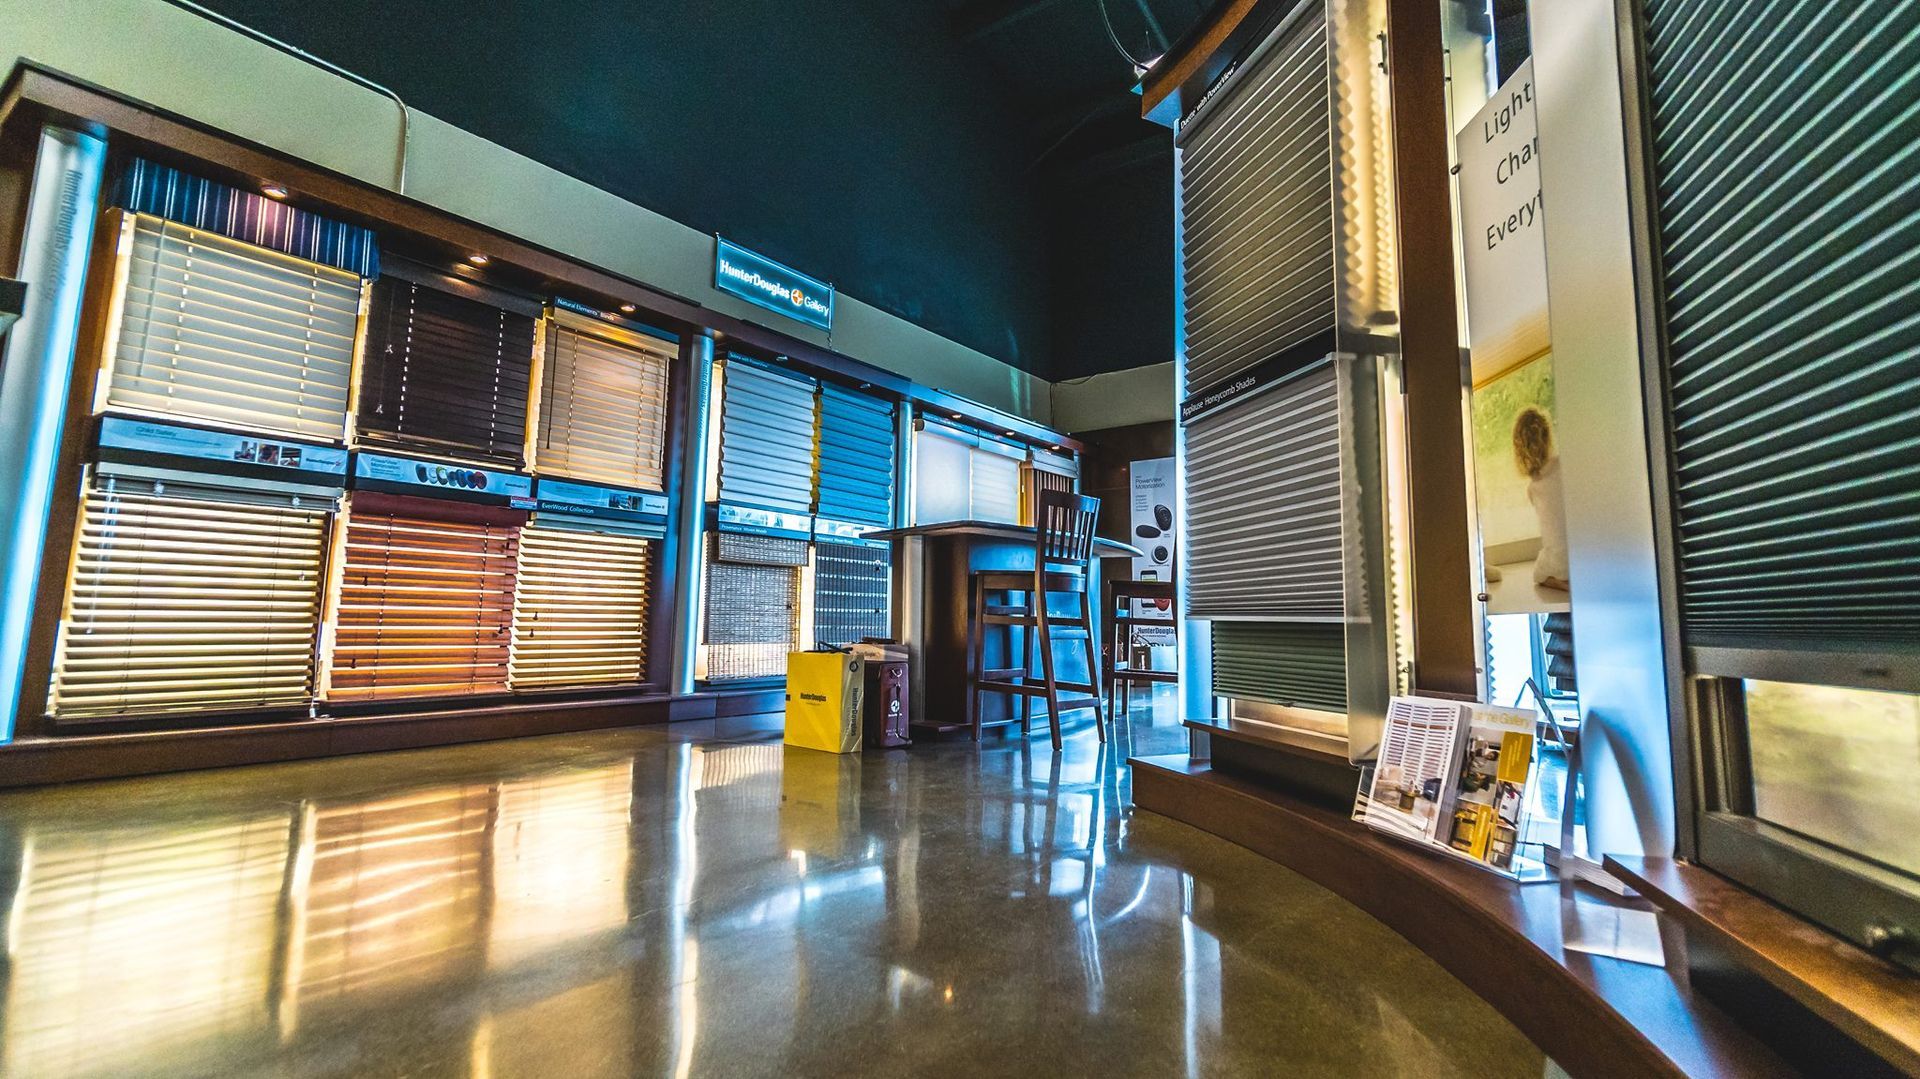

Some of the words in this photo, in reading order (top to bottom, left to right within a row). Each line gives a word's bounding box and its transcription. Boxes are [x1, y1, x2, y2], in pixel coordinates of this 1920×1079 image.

[1484, 81, 1532, 144] Light
[557, 298, 576, 310] Natural
[719, 259, 791, 299] HunterDouglas
[803, 297, 830, 316] Gallery
[1182, 401, 1204, 417] Applause
[1204, 385, 1236, 406] Honeycomb
[1235, 376, 1257, 392] Shades
[541, 502, 569, 511] EverWood
[569, 505, 595, 514] Collection
